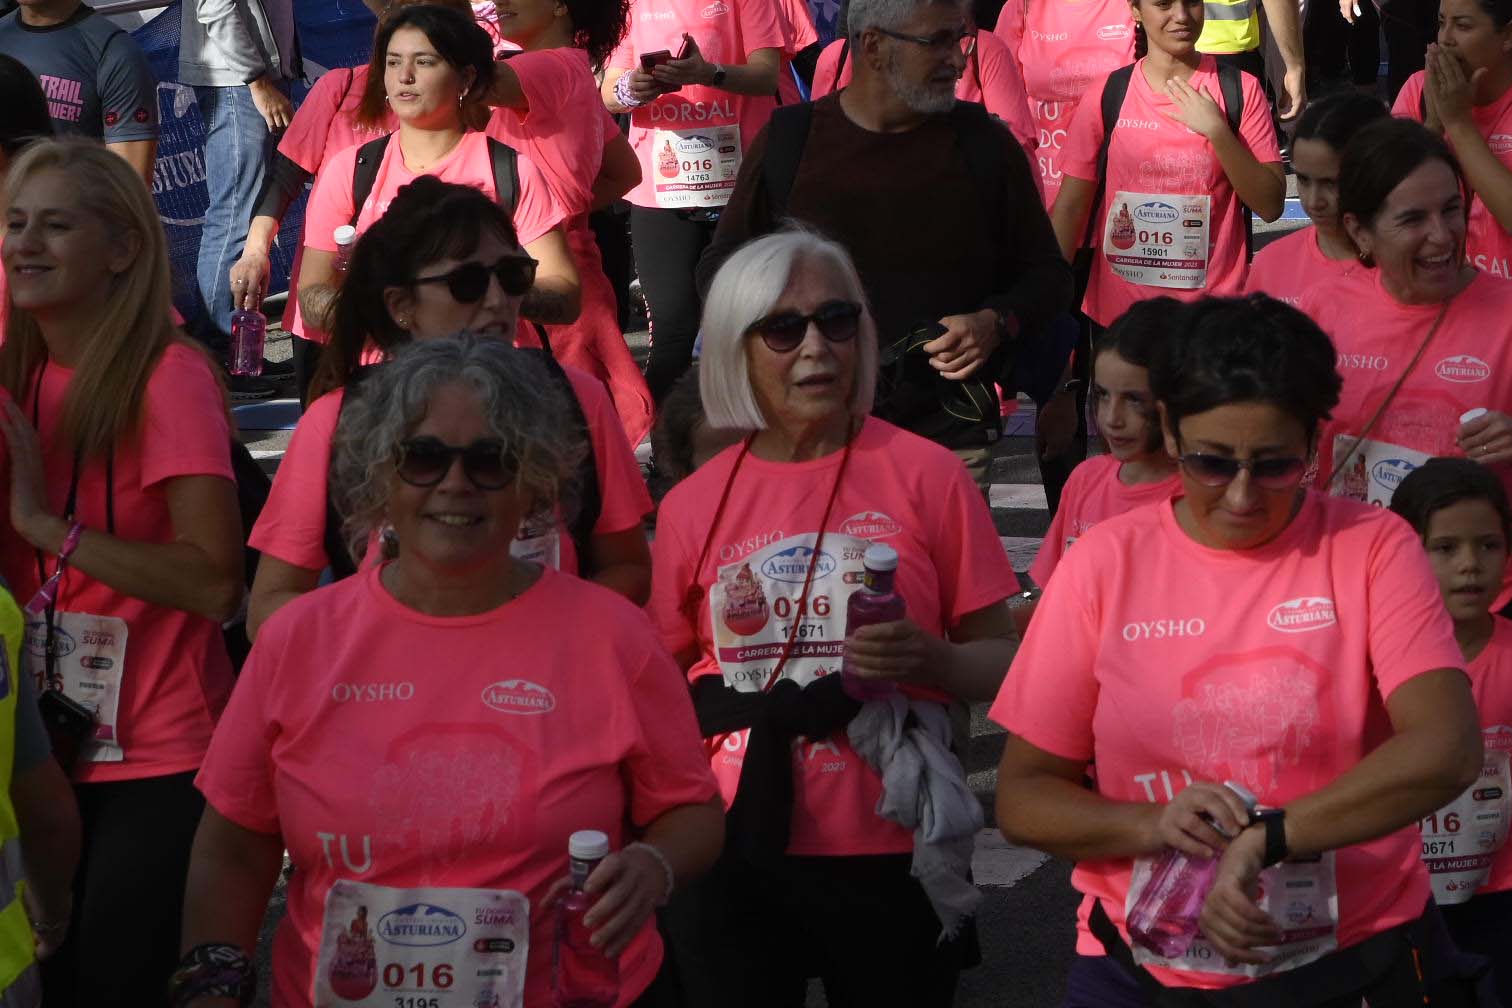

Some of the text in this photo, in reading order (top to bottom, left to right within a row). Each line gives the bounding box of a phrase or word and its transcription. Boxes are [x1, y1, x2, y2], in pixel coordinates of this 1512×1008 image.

[1031, 30, 1069, 41] OYSHO
[39, 74, 84, 105] TRAIL
[48, 102, 83, 123] WER!
[650, 99, 734, 122] DORSAL
[1116, 118, 1160, 130] OYSHO
[682, 159, 713, 172] 016
[687, 173, 710, 182] 14763
[1137, 208, 1176, 219] ASTURIANA
[1138, 230, 1174, 245] 016
[1142, 247, 1168, 257] 15901
[1115, 257, 1143, 265] CARRERA
[1167, 273, 1200, 281] Santander
[1438, 365, 1487, 377] ASTURIANA
[844, 522, 897, 535] ASTURIANA
[719, 529, 785, 562] OYSHO
[1273, 608, 1337, 628] ASTURIANA
[1122, 617, 1206, 641] OYSHO
[82, 634, 116, 648] SUMA
[736, 644, 844, 659] CARRERA LA MUJE
[332, 681, 415, 704] OYSHO
[486, 690, 552, 710] ASTURIANA
[821, 760, 847, 773] 2023
[316, 831, 373, 874] TU
[1434, 858, 1478, 870] LA MUJER
[474, 914, 515, 925] SUMA
[382, 920, 460, 937] ASTURIANA
[383, 962, 455, 989] 016
